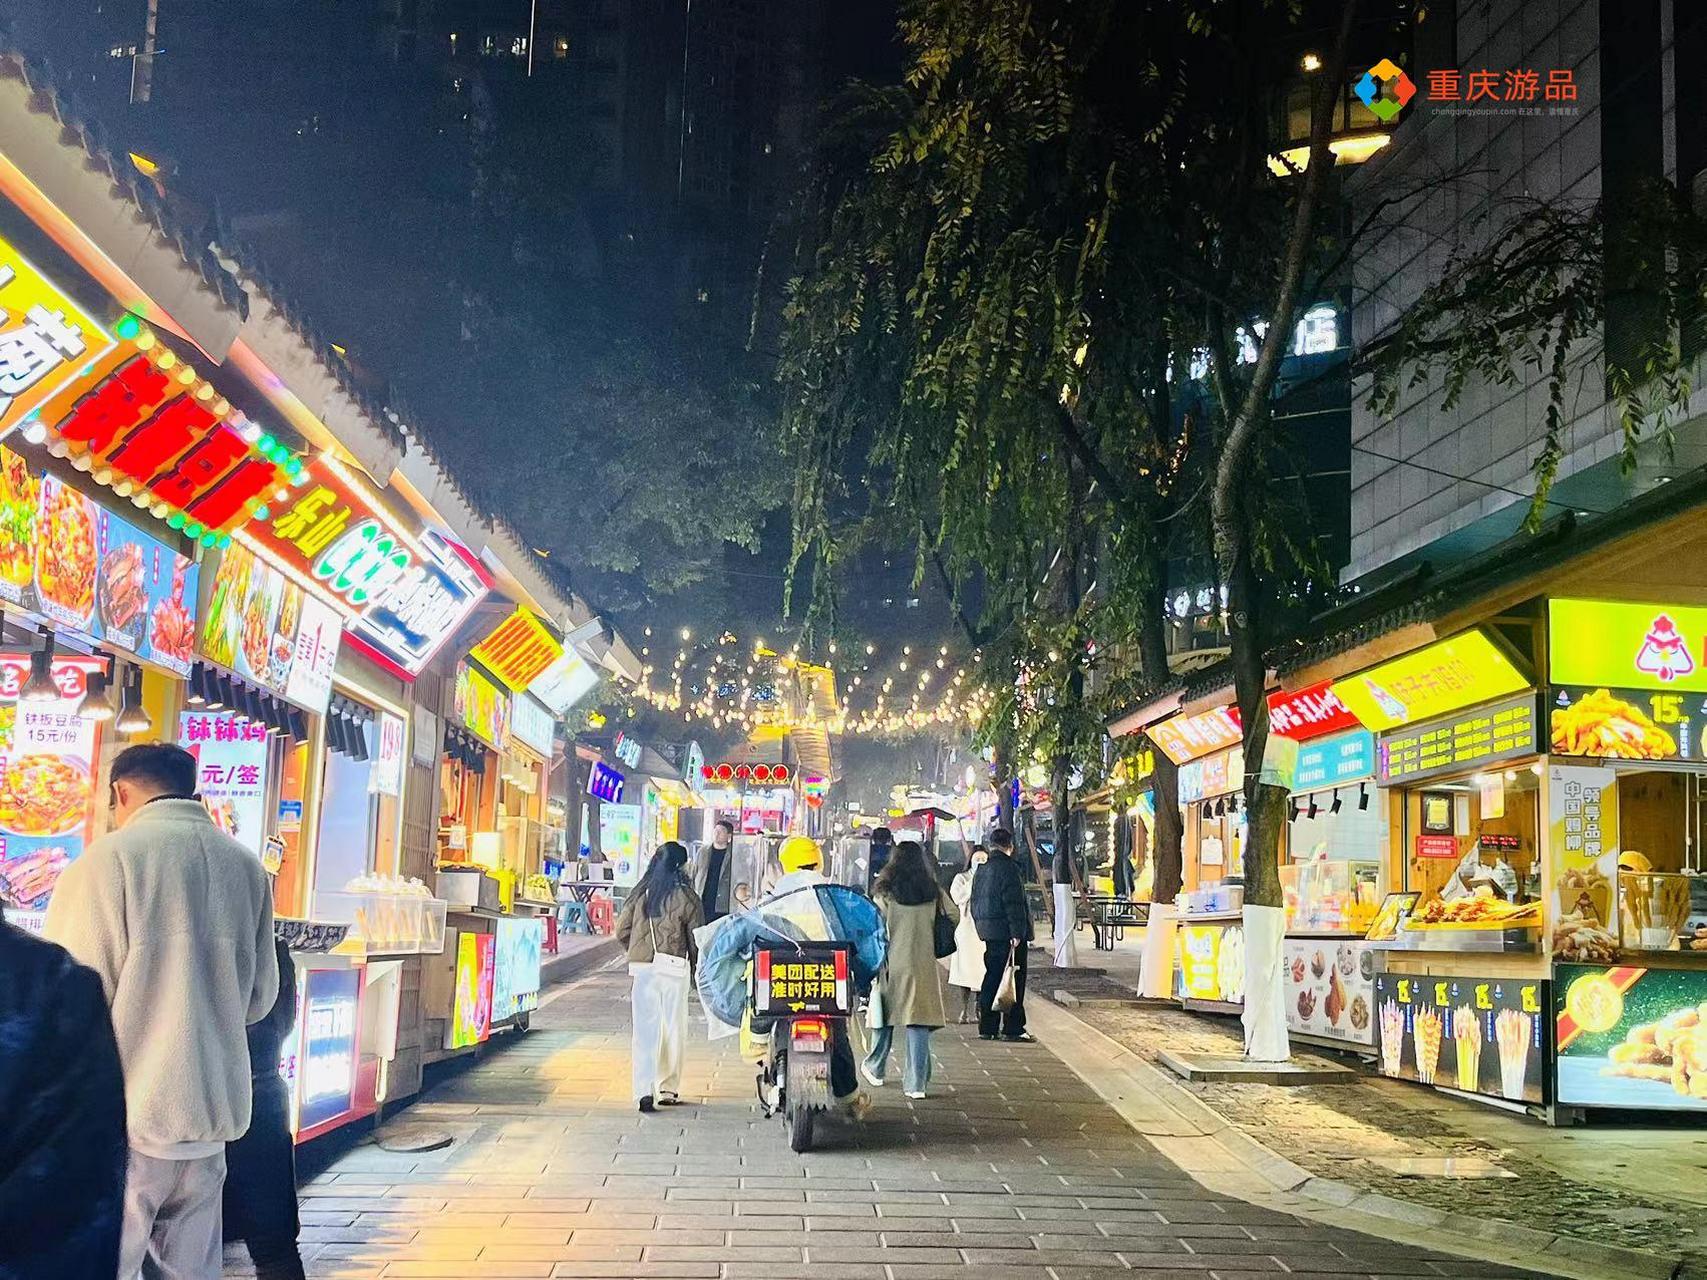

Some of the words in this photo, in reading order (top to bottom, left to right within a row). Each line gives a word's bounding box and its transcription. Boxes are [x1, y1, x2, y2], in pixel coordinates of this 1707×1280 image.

[25, 712, 82, 726] 铁板豆腐
[28, 729, 77, 743] 15元/份
[202, 765, 260, 784] 元/签
[771, 964, 835, 981] 美团配送
[771, 981, 835, 999] 准时好用
